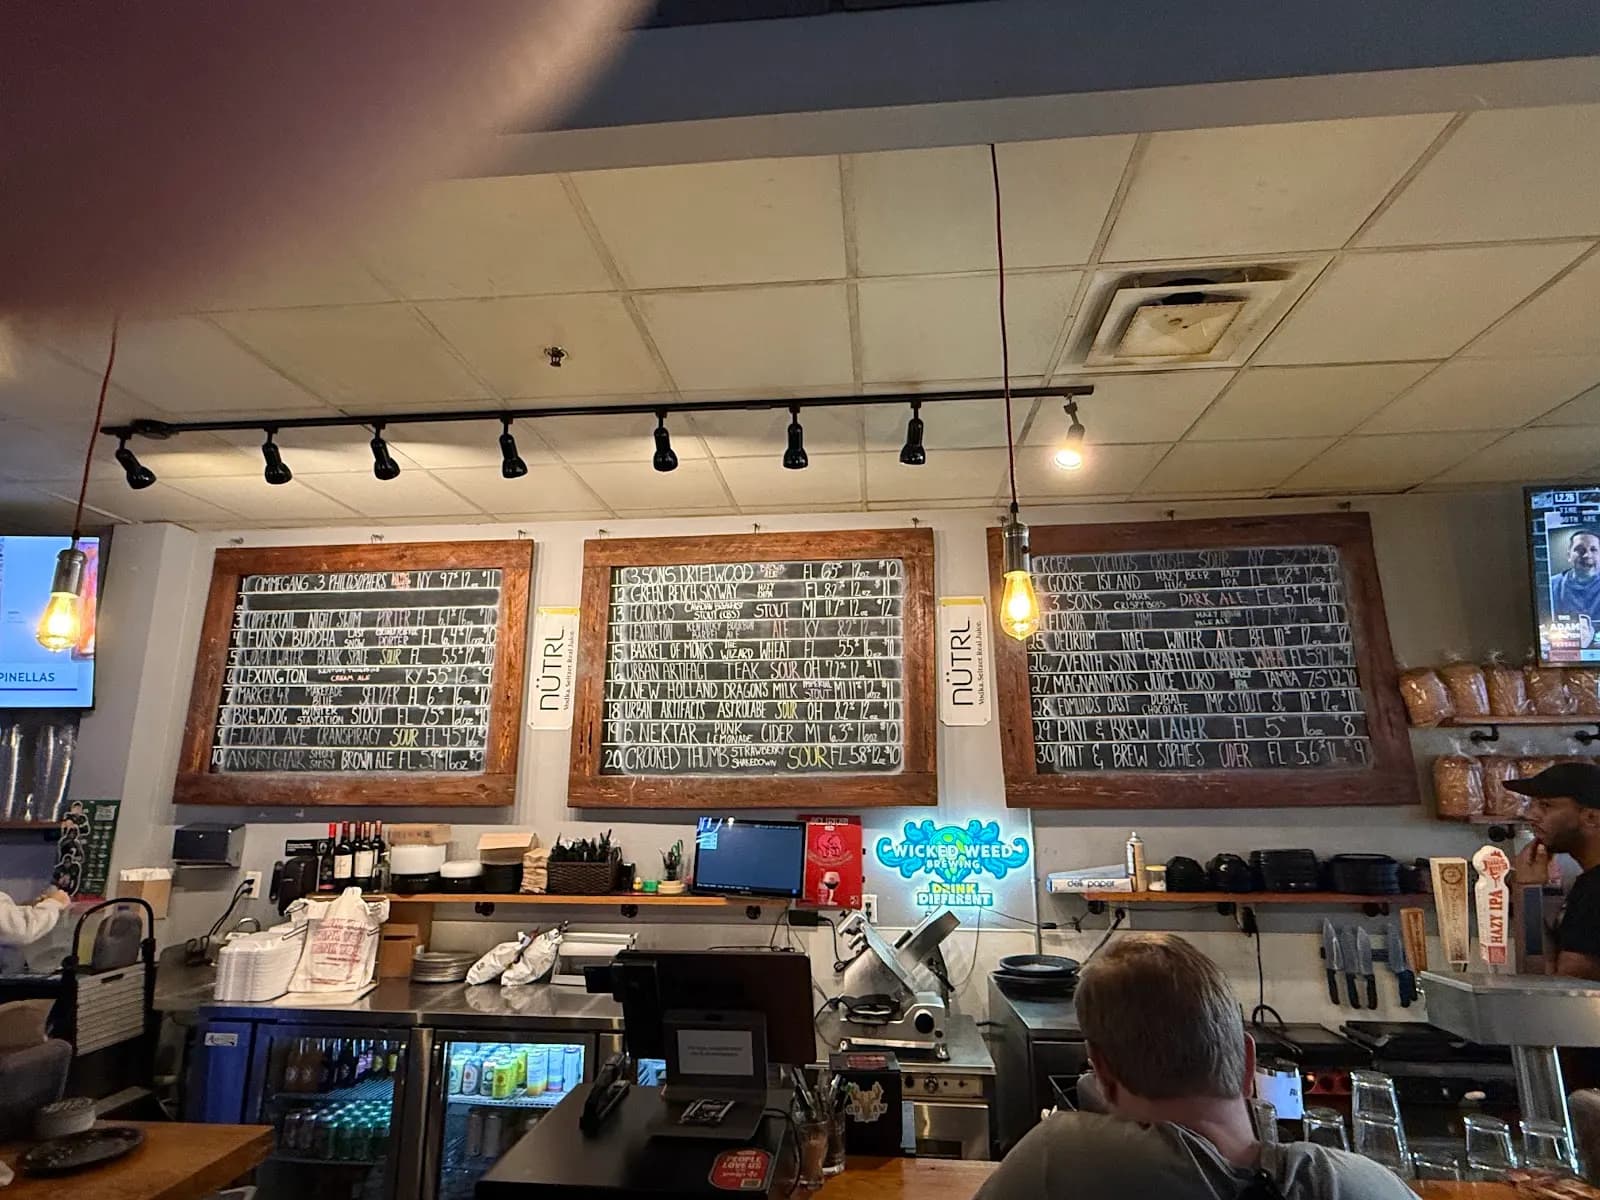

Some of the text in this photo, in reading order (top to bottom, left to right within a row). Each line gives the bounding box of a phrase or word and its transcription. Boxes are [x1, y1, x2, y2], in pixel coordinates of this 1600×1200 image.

[255, 574, 309, 592] OMMEGANG
[314, 574, 326, 591] 3
[328, 571, 388, 591] PHILOSOPHERS
[417, 571, 433, 589] NY
[641, 566, 677, 585] SONS
[679, 563, 754, 585] DRIFTWOOD
[803, 562, 817, 580] FL
[1047, 573, 1088, 593] GOOSE
[1096, 572, 1142, 592] ISLAND
[1154, 569, 1180, 582] HAZY
[1184, 569, 1210, 581] BEER
[630, 581, 825, 602] GREEN BENCH SKYWAY FL
[1049, 594, 1060, 611] 3
[1066, 593, 1103, 611] SONS
[1123, 592, 1152, 602] DARK
[1179, 591, 1216, 608] DARK
[1219, 590, 1249, 606] ALE
[1255, 587, 1279, 606] FL
[754, 601, 791, 618] STOUT
[801, 599, 817, 618] MI
[629, 622, 674, 641] LEXINGTON
[686, 621, 721, 633] KENTUCKY
[772, 620, 789, 639] ALE
[804, 620, 820, 639] KY
[1048, 612, 1087, 631] FLORIDA
[248, 629, 286, 649] FUNKY
[291, 628, 337, 648] BUDDHA
[421, 627, 438, 646] FL
[1053, 632, 1098, 651] DELIRIUM
[1121, 631, 1150, 651] NOEL
[1163, 629, 1205, 650] WINTER
[1215, 628, 1237, 648] ALE
[630, 642, 668, 660] BARREL
[669, 641, 681, 659] OF
[683, 641, 714, 660] MONKS
[720, 648, 754, 659] WIZARD
[759, 640, 792, 659] WHEAT
[804, 640, 818, 659] FL
[1050, 648, 1197, 673] 7VENTH SUN GRAFFITI
[240, 667, 308, 684] LEXINGTON
[405, 668, 422, 684] KY
[625, 659, 821, 681] URBAN ARTIFACT TEAK SOUR OH
[630, 682, 661, 700] NEW
[667, 682, 719, 700] HOLLAND
[723, 681, 768, 699] DRAGON'S
[772, 681, 799, 699] MILK
[804, 688, 831, 700] STOUT
[1052, 668, 1302, 694] MAGNANIMOUS JUICE LORD TAMPA
[237, 687, 276, 704] MARKER
[1056, 691, 1264, 717] EDMUNDS OAST CHOCOLATE STOUT
[232, 706, 414, 725] BREWDOG WINTER STAYCATION STOUT FL
[624, 700, 823, 720] URBAN ARTIFACTS ASTROLABE SOUR OH
[228, 726, 440, 747] FLORIDA AVE CRANSPIRACY SOUR FL
[623, 720, 821, 745] B. NEKTAR PUNK LEMONADE CIDER MI
[1056, 715, 1255, 742] PINT BREW LAGER FL
[375, 750, 395, 769] ALE
[399, 749, 416, 769] FL
[604, 748, 623, 769] 20
[624, 745, 681, 770] CROOKED
[686, 745, 730, 769] THUMB
[730, 745, 785, 758] STRAWBERRY
[786, 744, 833, 770] SOUR
[830, 745, 848, 766] FL
[1036, 740, 1289, 769] 30 PINT BREW SOPHIE'S CIDER FL
[893, 843, 1013, 858] WICKED WEED
[926, 859, 981, 869] BREWING
[918, 893, 991, 905] DIFFERENT
[932, 884, 976, 893] DRINK
[1488, 889, 1503, 944] HAZY IPA
